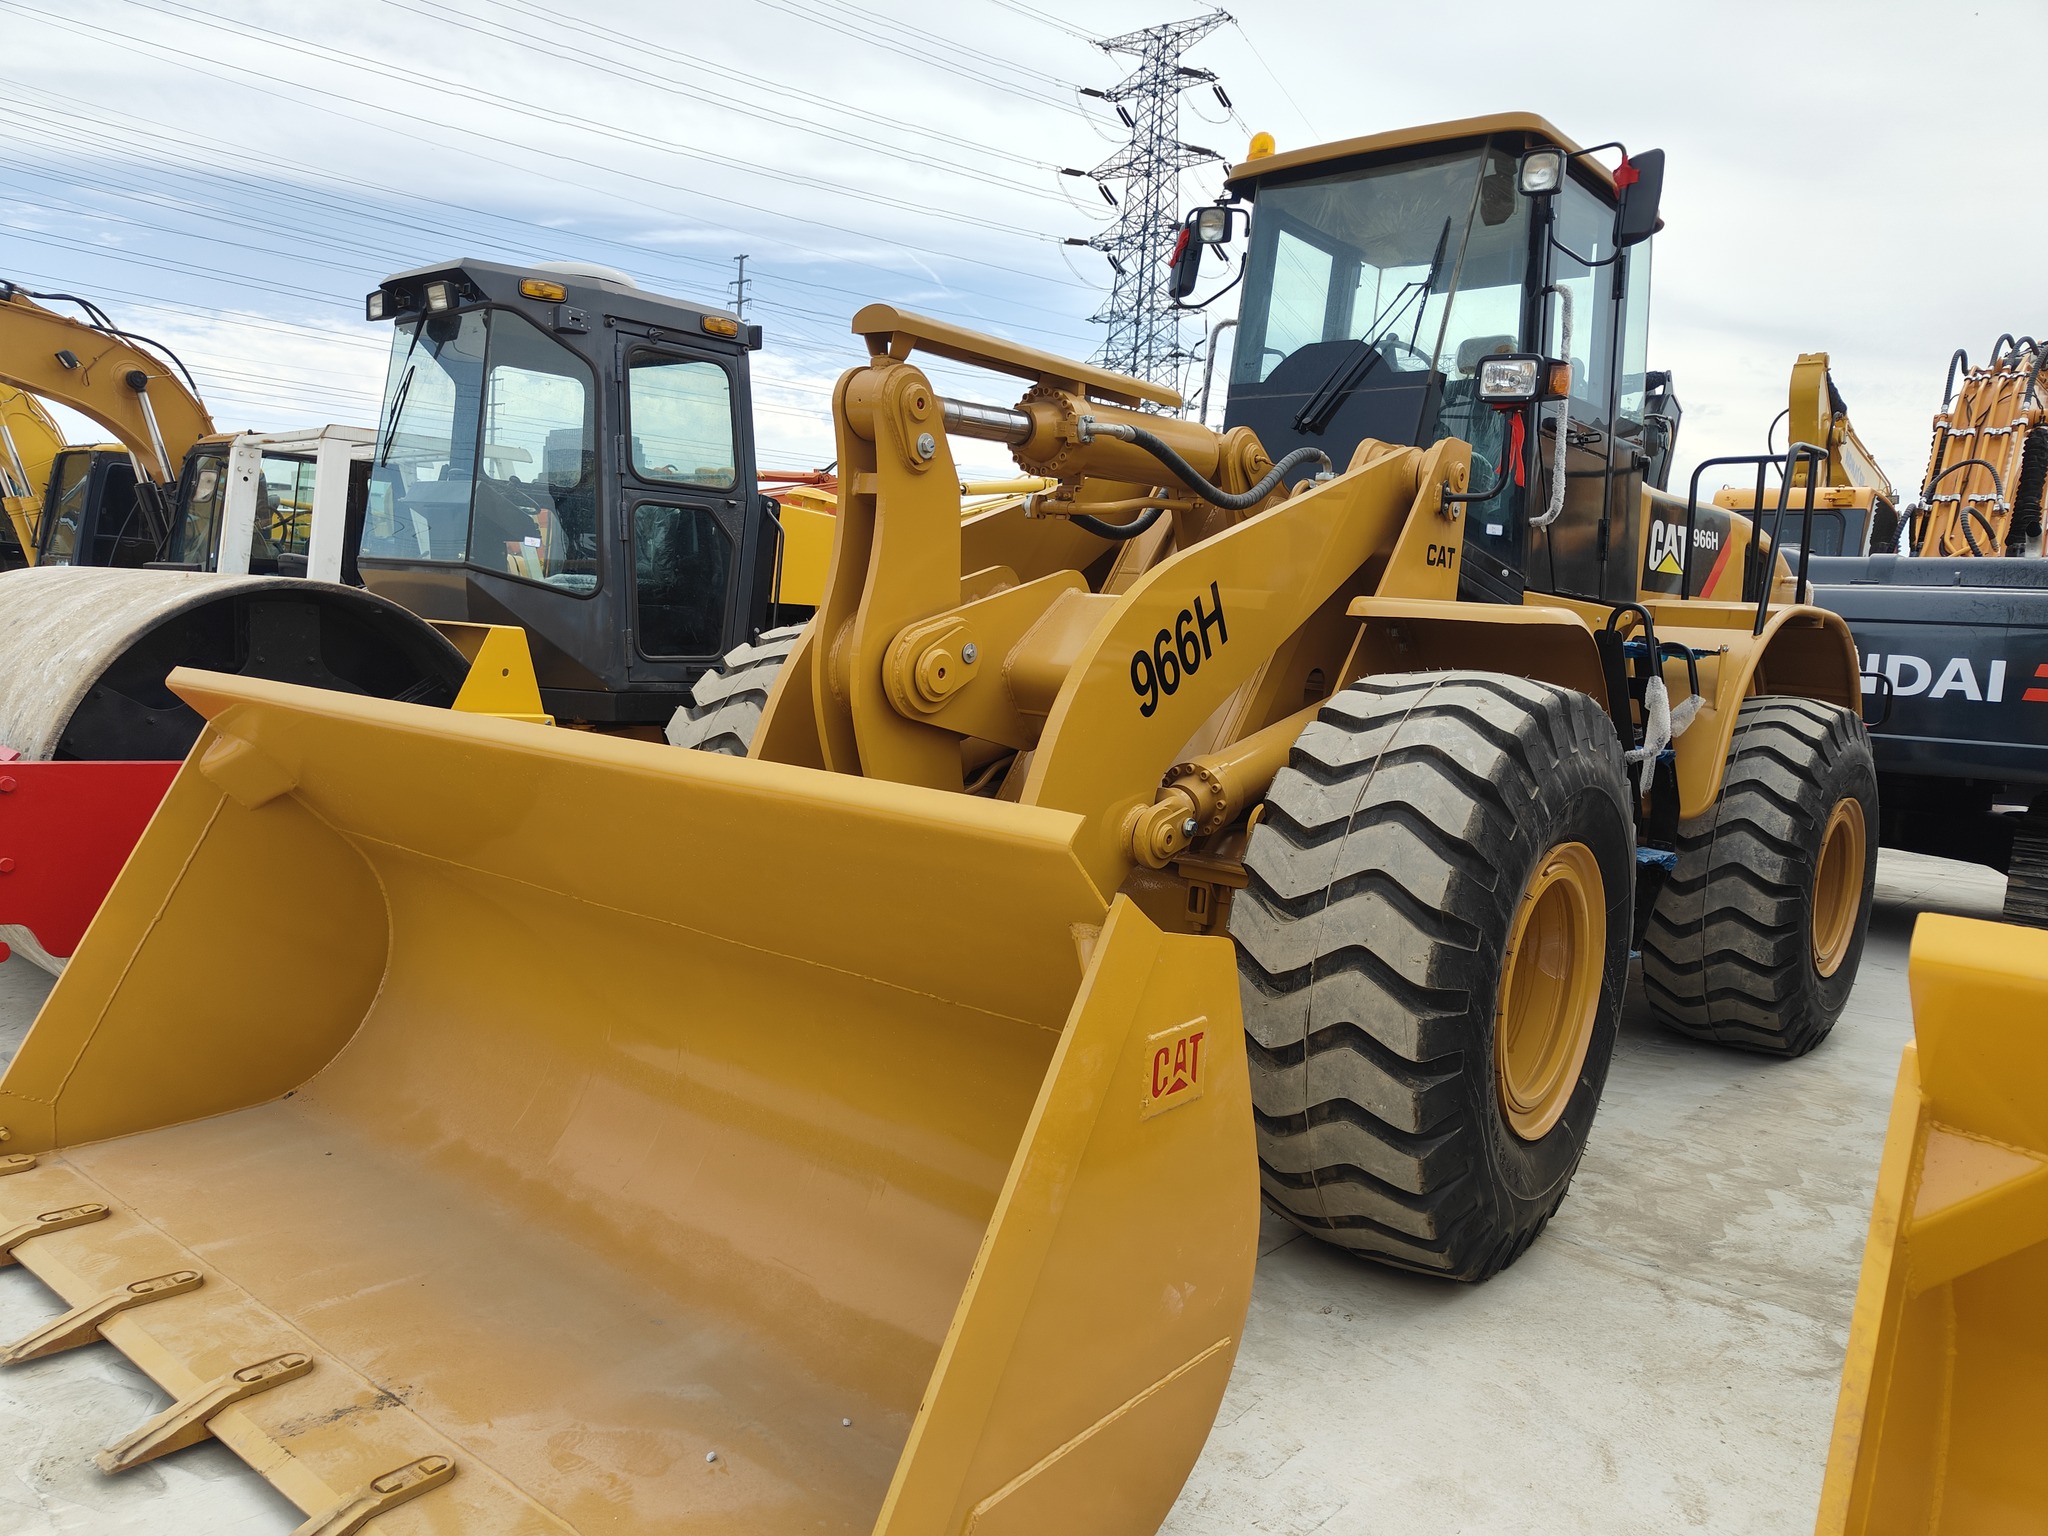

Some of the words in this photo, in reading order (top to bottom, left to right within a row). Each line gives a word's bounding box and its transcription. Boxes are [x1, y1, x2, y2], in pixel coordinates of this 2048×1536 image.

[1426, 543, 1456, 569] CAT
[1648, 519, 1687, 572] CAT
[1693, 528, 1719, 551] 966H
[1130, 580, 1229, 718] 966H
[1151, 1031, 1204, 1099] CAT
